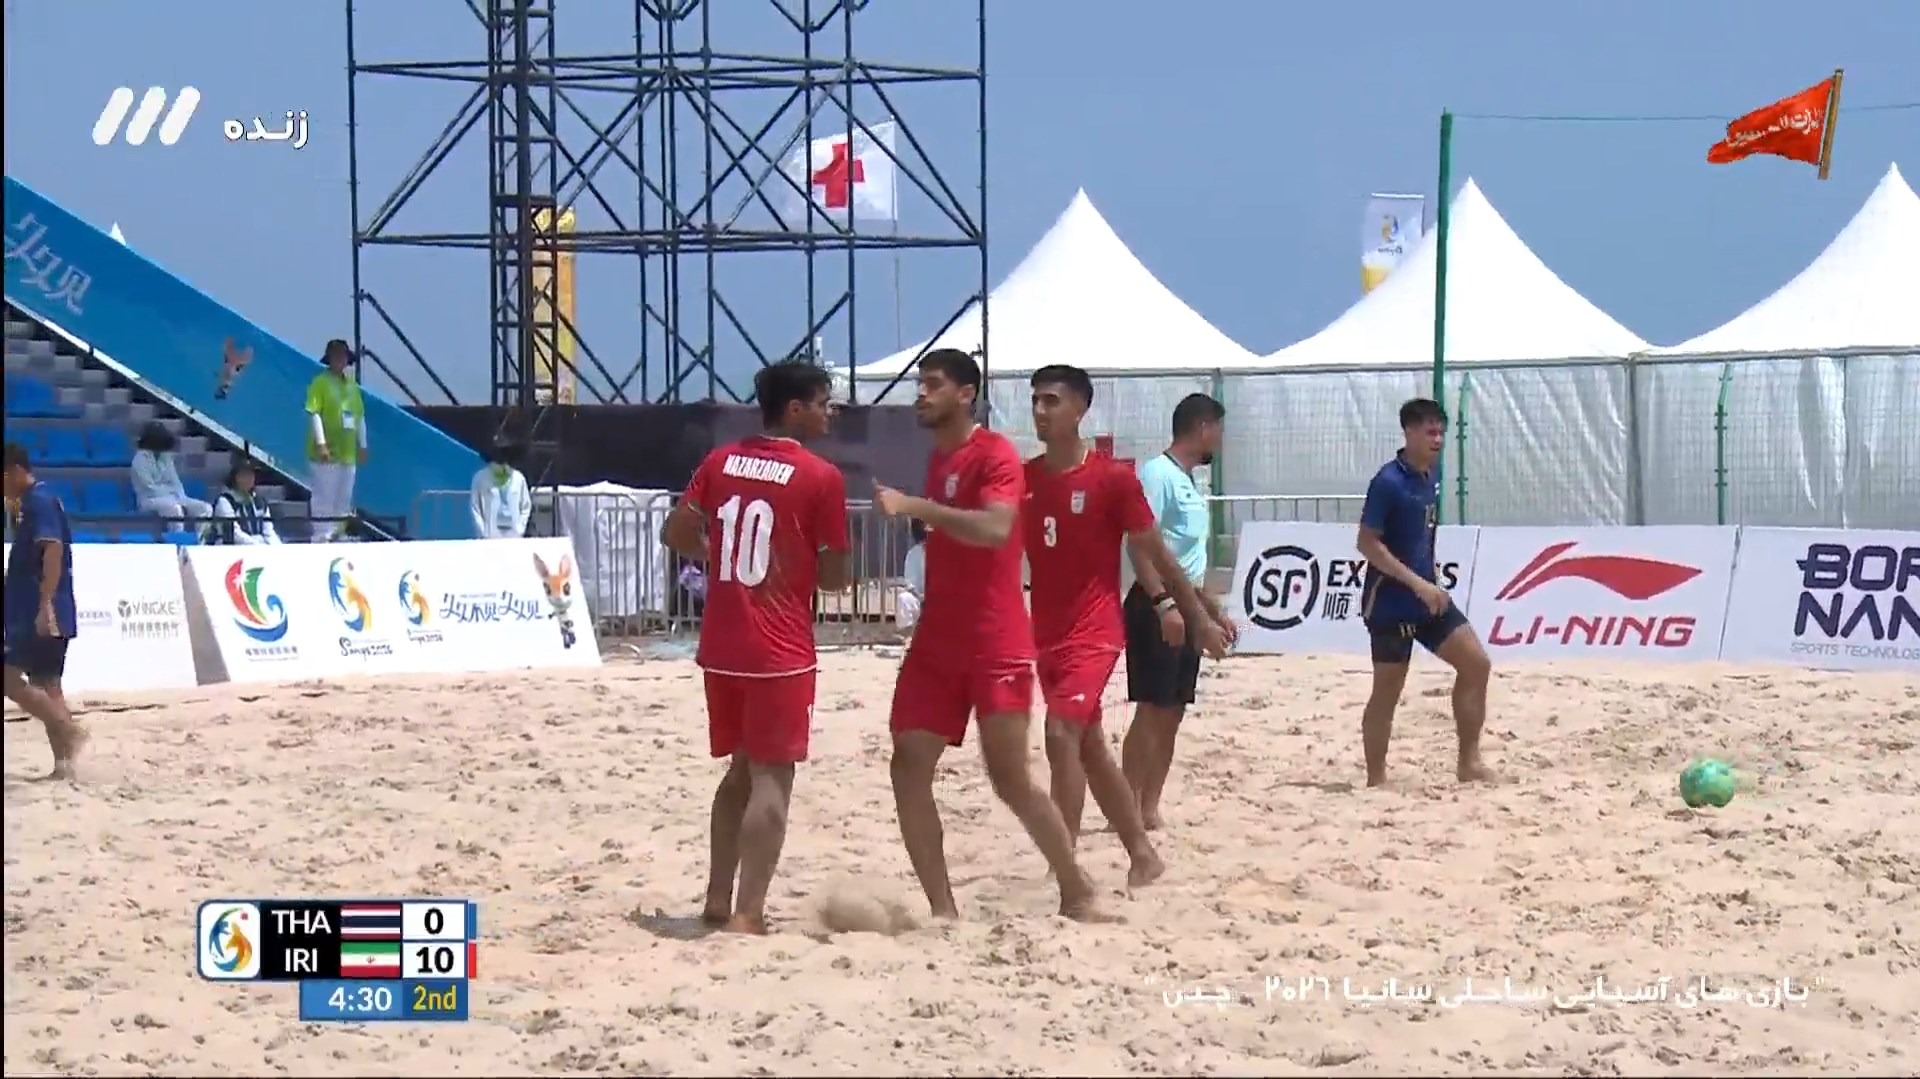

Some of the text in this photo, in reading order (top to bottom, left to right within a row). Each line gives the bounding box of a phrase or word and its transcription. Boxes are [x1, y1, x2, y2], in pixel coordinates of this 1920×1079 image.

[722, 454, 796, 486] NAZARZADEH
[716, 494, 775, 587] 10
[1043, 515, 1058, 548] 3
[1487, 615, 1697, 647] LI-NING
[1791, 643, 1838, 656] SPORTS
